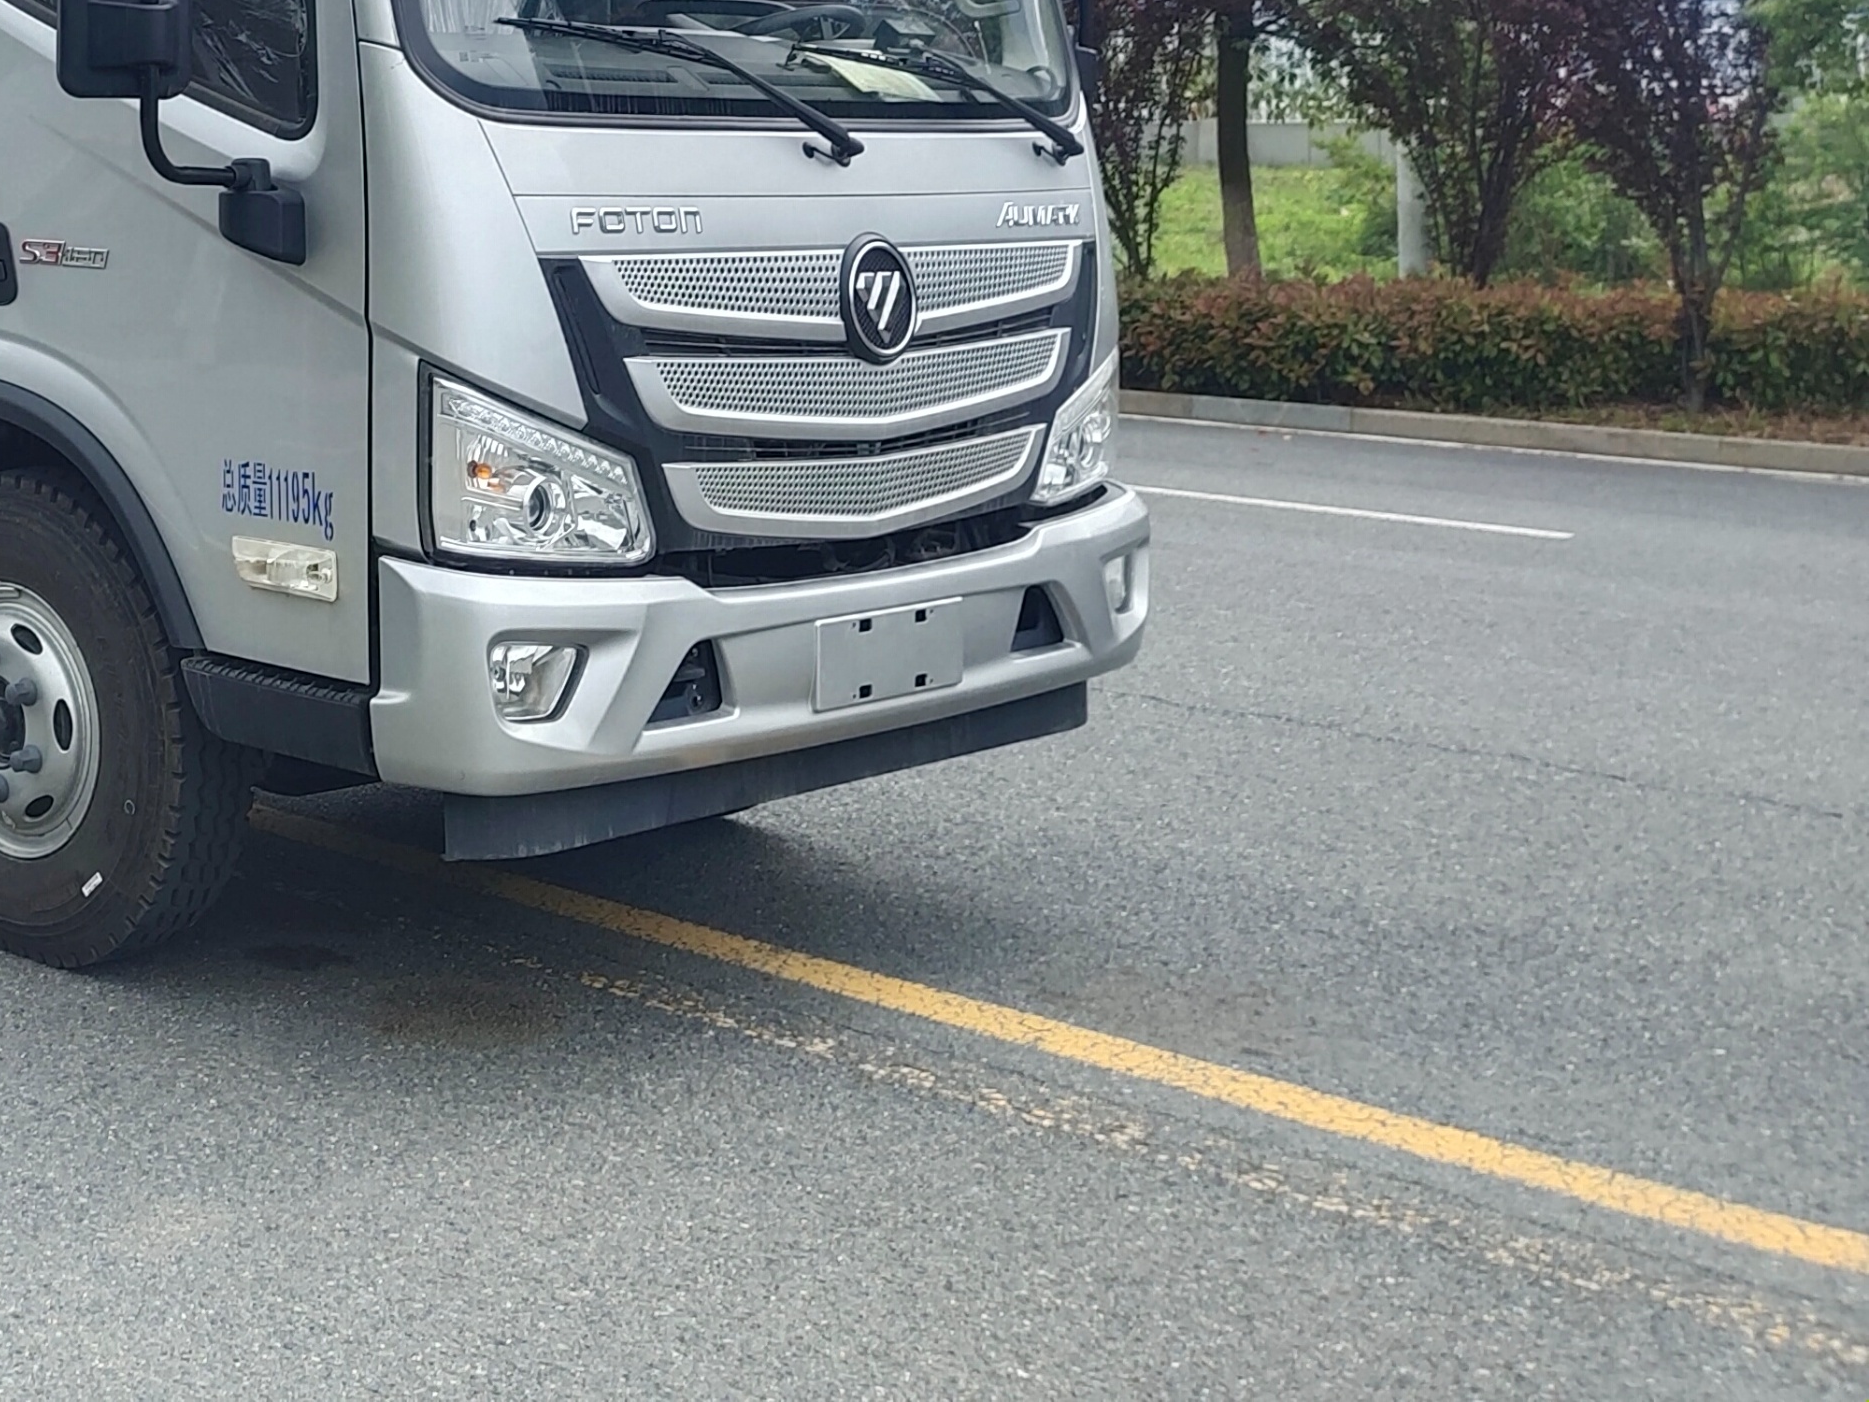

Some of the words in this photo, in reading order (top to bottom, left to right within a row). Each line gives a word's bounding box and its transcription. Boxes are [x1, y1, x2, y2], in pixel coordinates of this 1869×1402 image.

[570, 206, 703, 235] FOTON
[222, 459, 335, 541] 总质量11195kg
